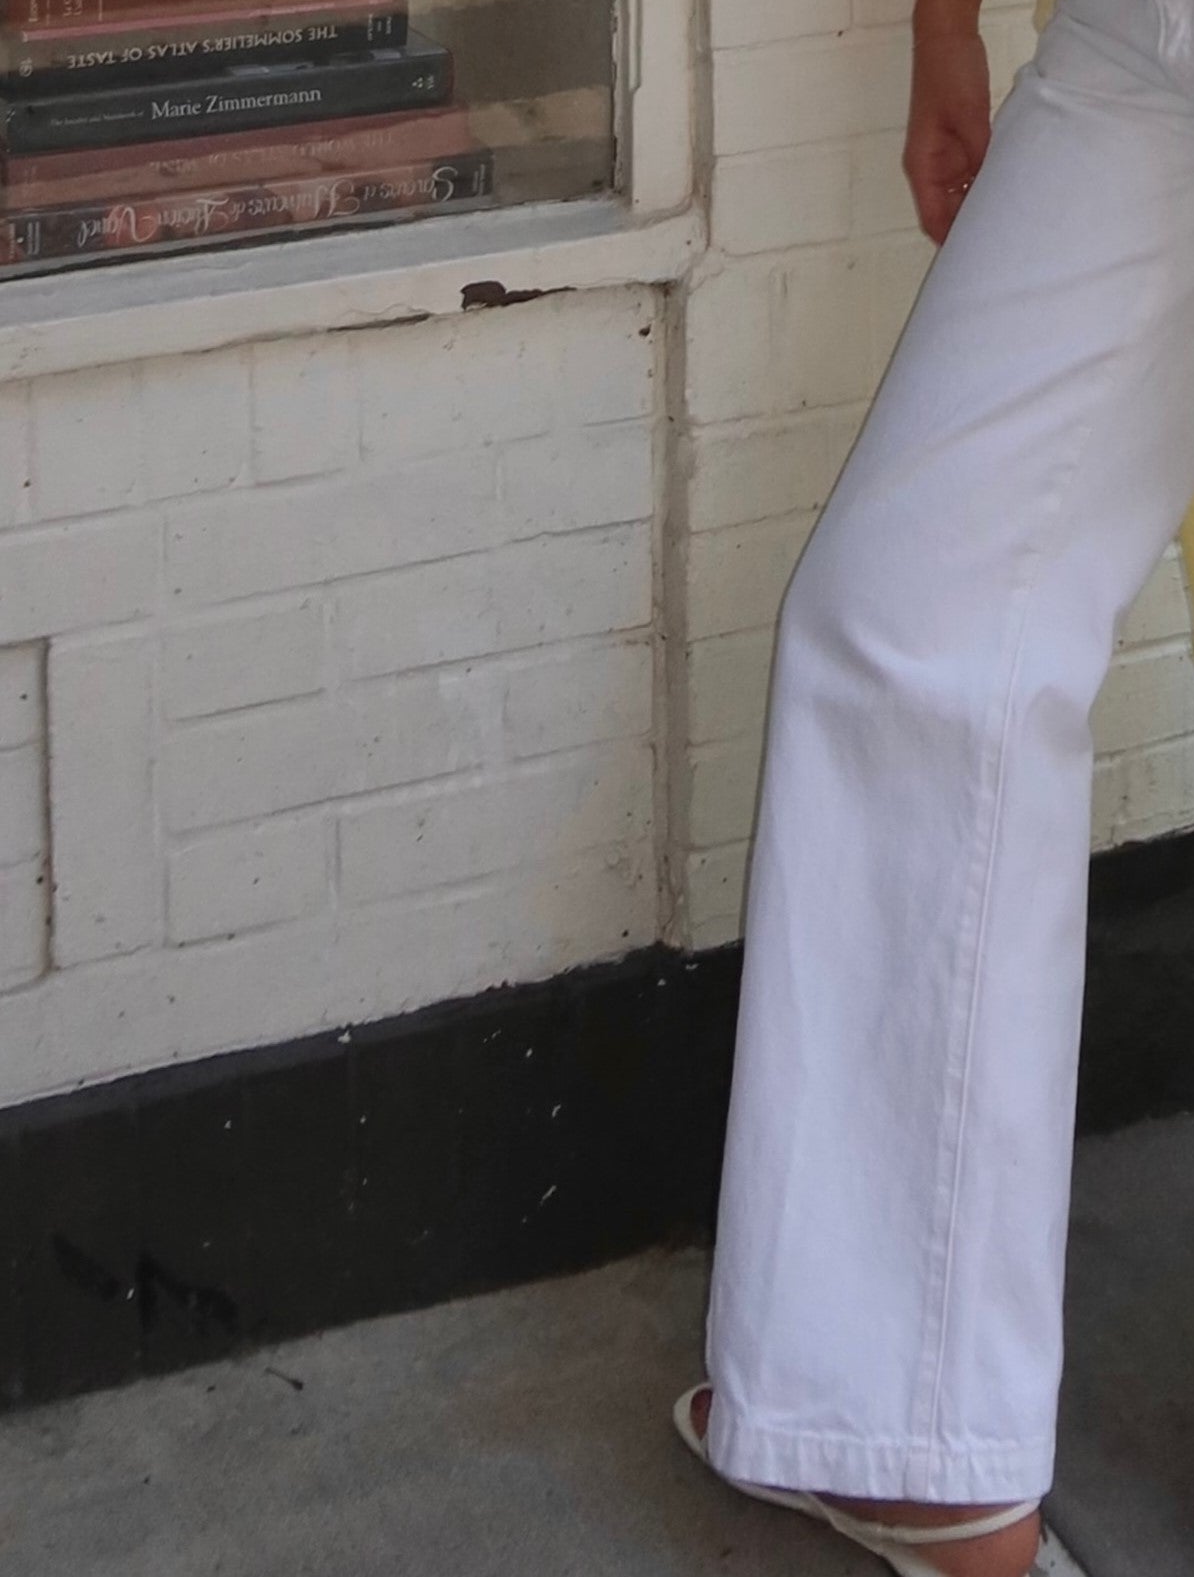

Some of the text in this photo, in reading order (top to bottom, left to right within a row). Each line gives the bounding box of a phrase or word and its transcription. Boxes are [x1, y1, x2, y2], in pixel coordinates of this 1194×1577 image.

[67, 24, 339, 69] THE SOMMELIER'S ATLAS OF TASTE
[151, 99, 202, 120] Marie
[205, 88, 322, 114] Zimmermann
